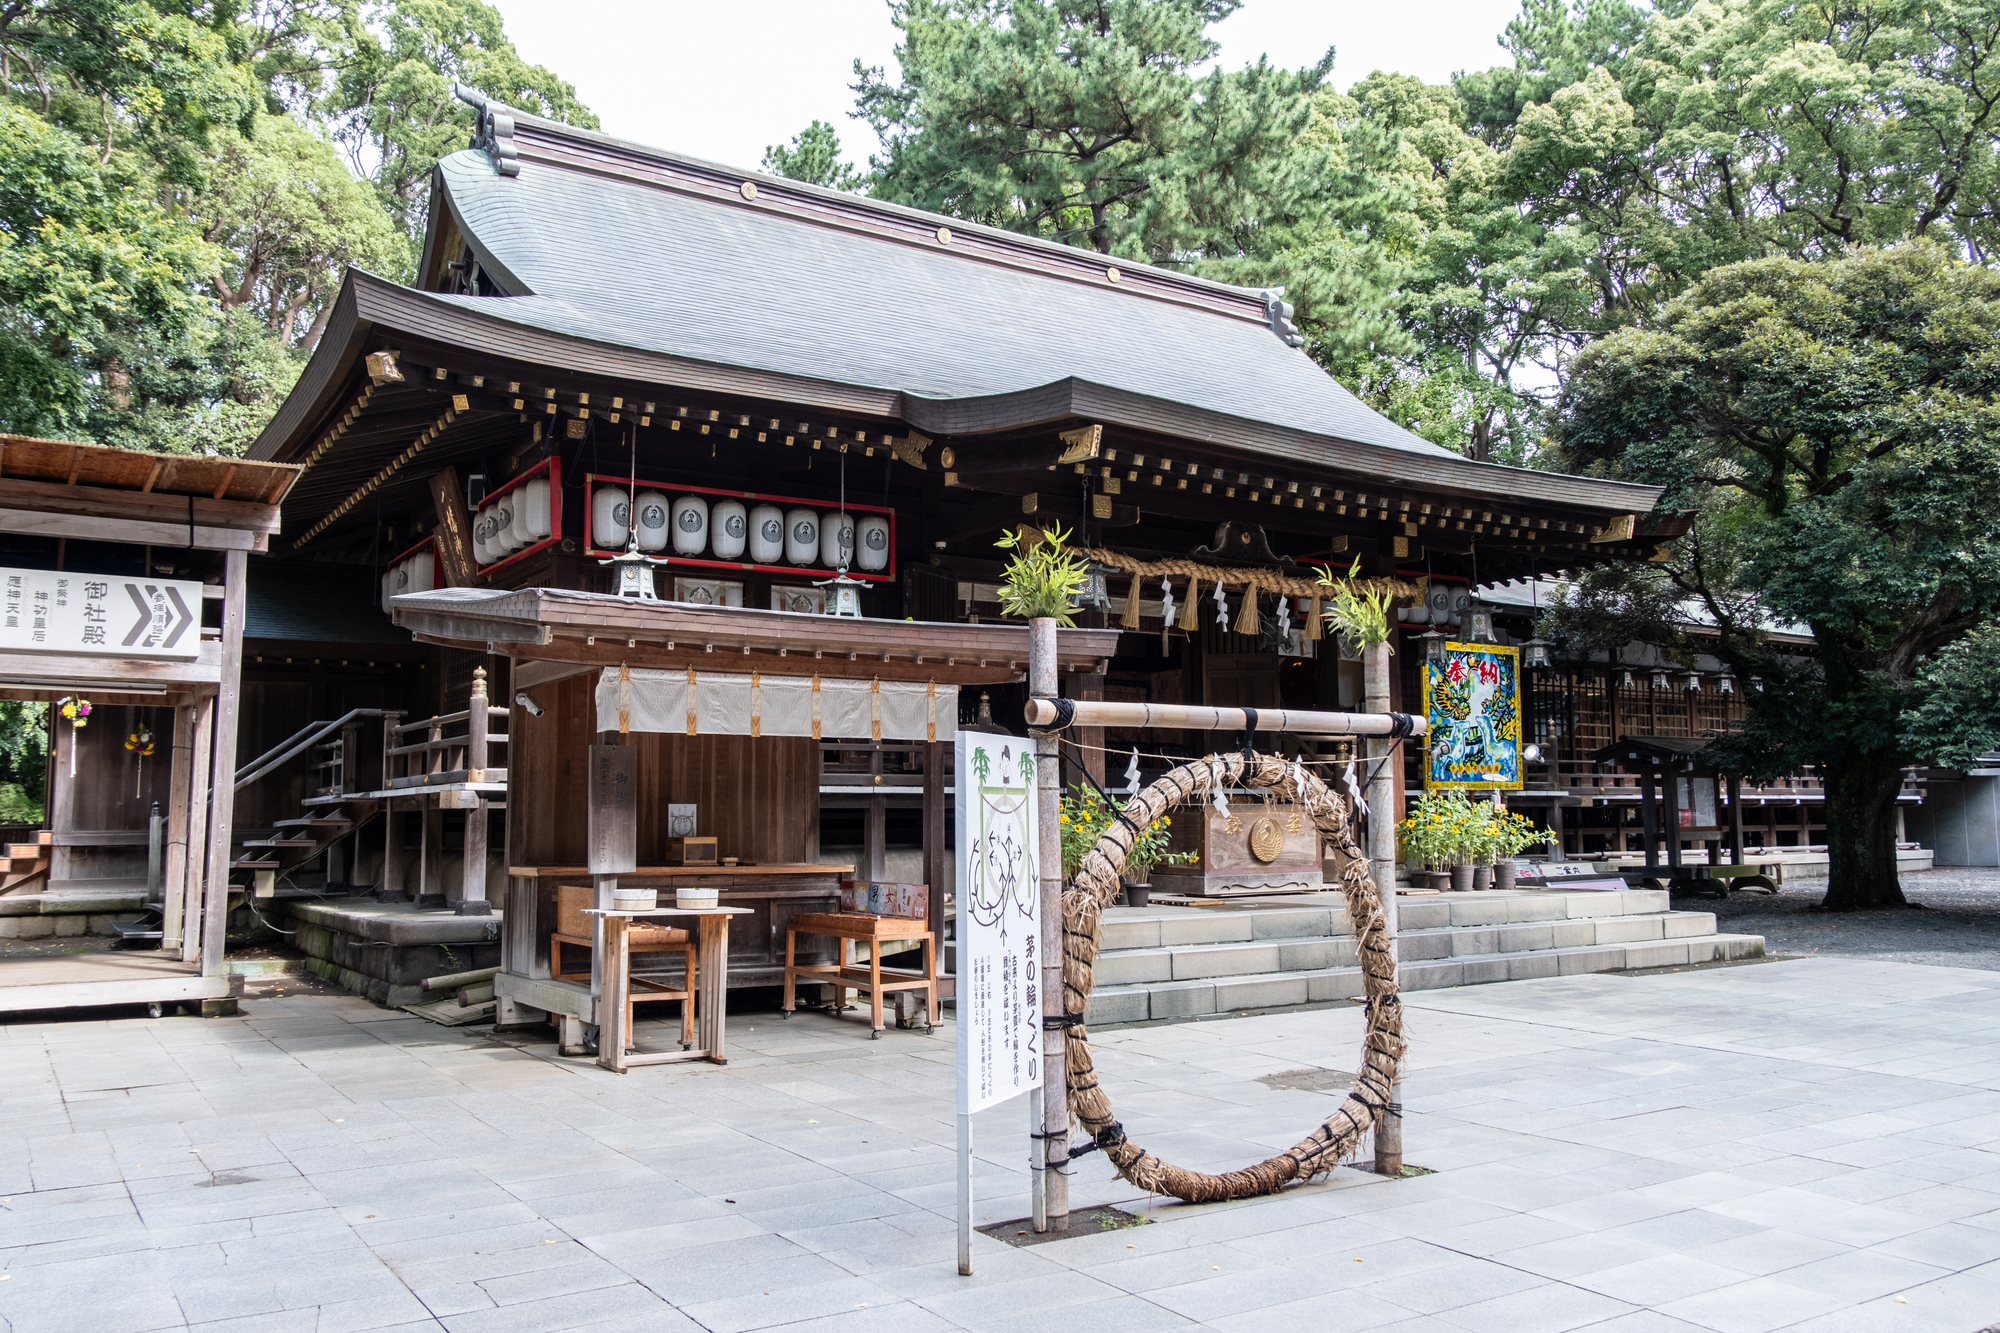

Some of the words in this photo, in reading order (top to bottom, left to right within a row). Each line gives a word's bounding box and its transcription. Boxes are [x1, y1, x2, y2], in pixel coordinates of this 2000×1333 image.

[5, 575, 22, 628] 應神天皇
[32, 590, 48, 642] 神功皇后
[56, 578, 68, 608] 御祭神
[81, 580, 108, 645] 御社殿
[152, 592, 166, 641] 参拝順路二
[1447, 659, 1499, 686] 奉納
[871, 885, 879, 903] 男
[885, 887, 894, 904] 女
[1025, 934, 1038, 1081] 茅の輪くぐり
